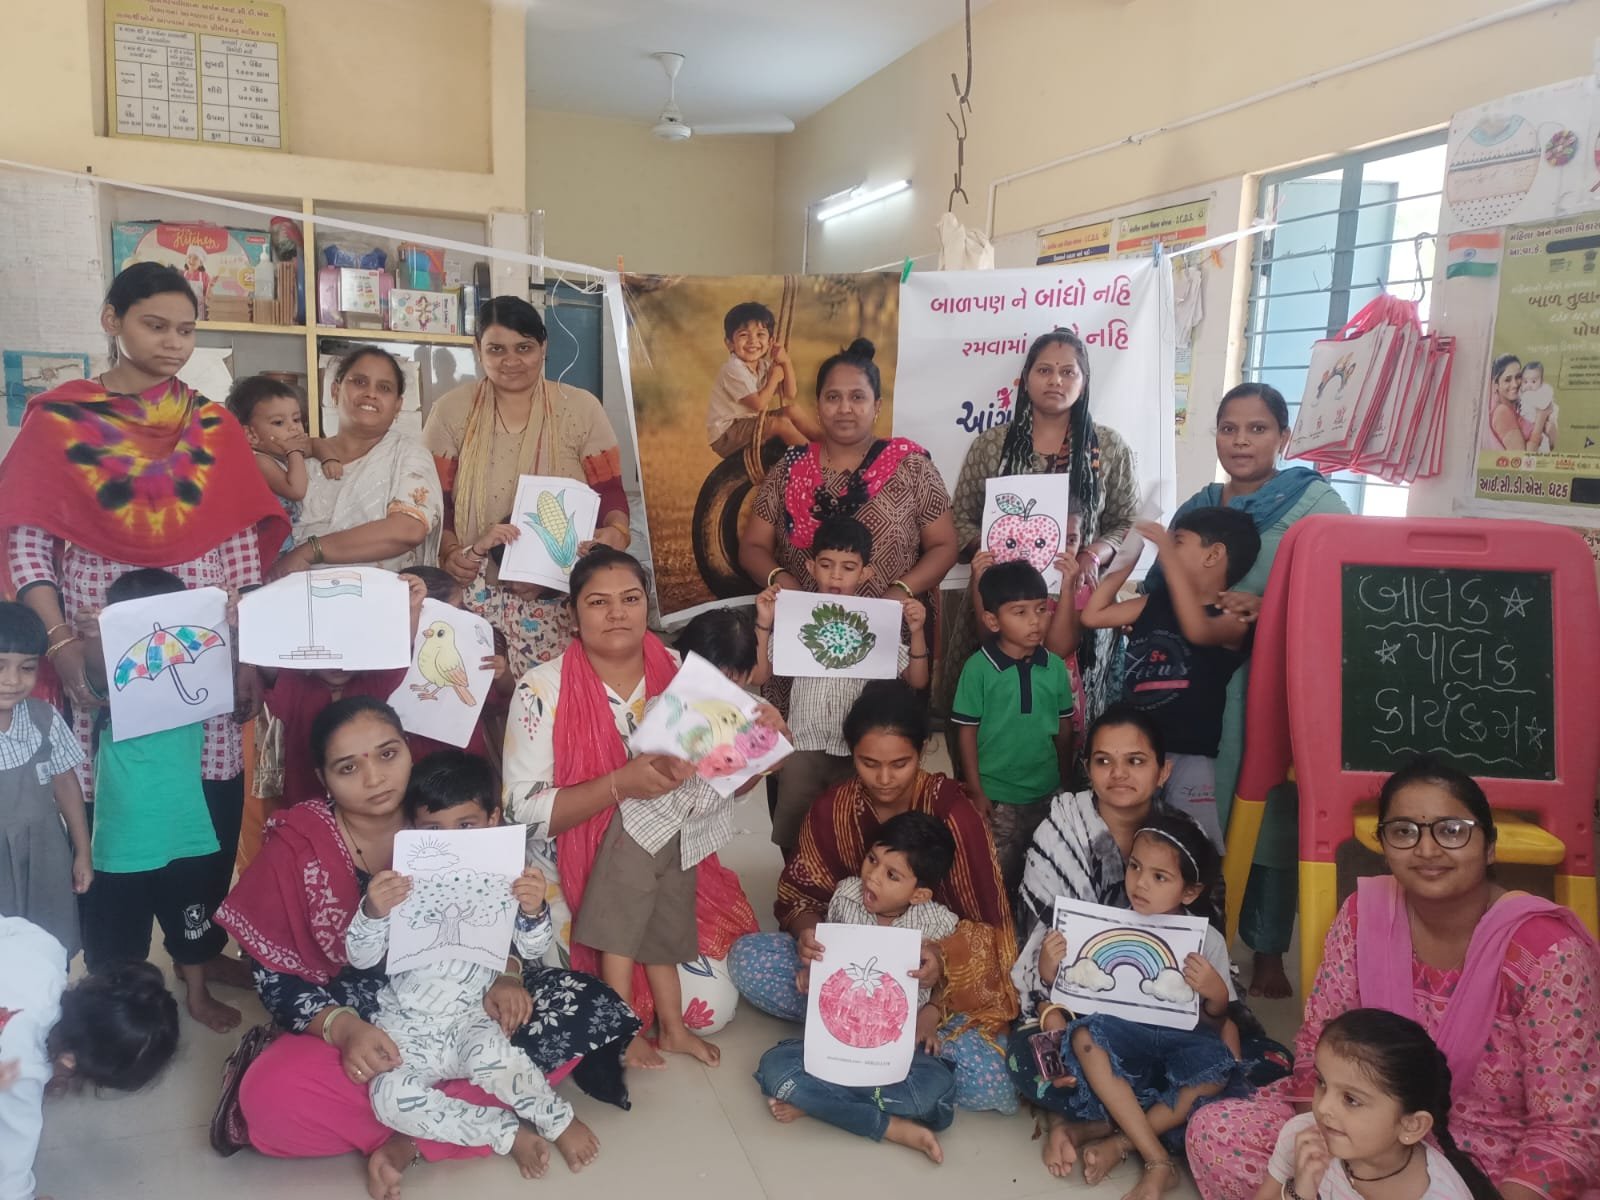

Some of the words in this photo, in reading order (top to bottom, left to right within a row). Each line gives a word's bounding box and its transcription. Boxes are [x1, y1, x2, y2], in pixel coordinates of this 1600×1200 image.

[930, 294, 1005, 315] બાળપણ
[1011, 287, 1028, 310] ને
[1034, 278, 1086, 308] બાંધો
[1092, 274, 1132, 306] નહિ
[1529, 294, 1562, 308] બાળ
[961, 332, 1027, 358] રમવામાં
[1085, 318, 1130, 351] નહિ
[1479, 474, 1545, 497] આઈ.સી.ડી.એસ.
[1548, 481, 1569, 498] ઘટક
[1358, 575, 1489, 624] બાલક
[1406, 631, 1517, 686] પાલક
